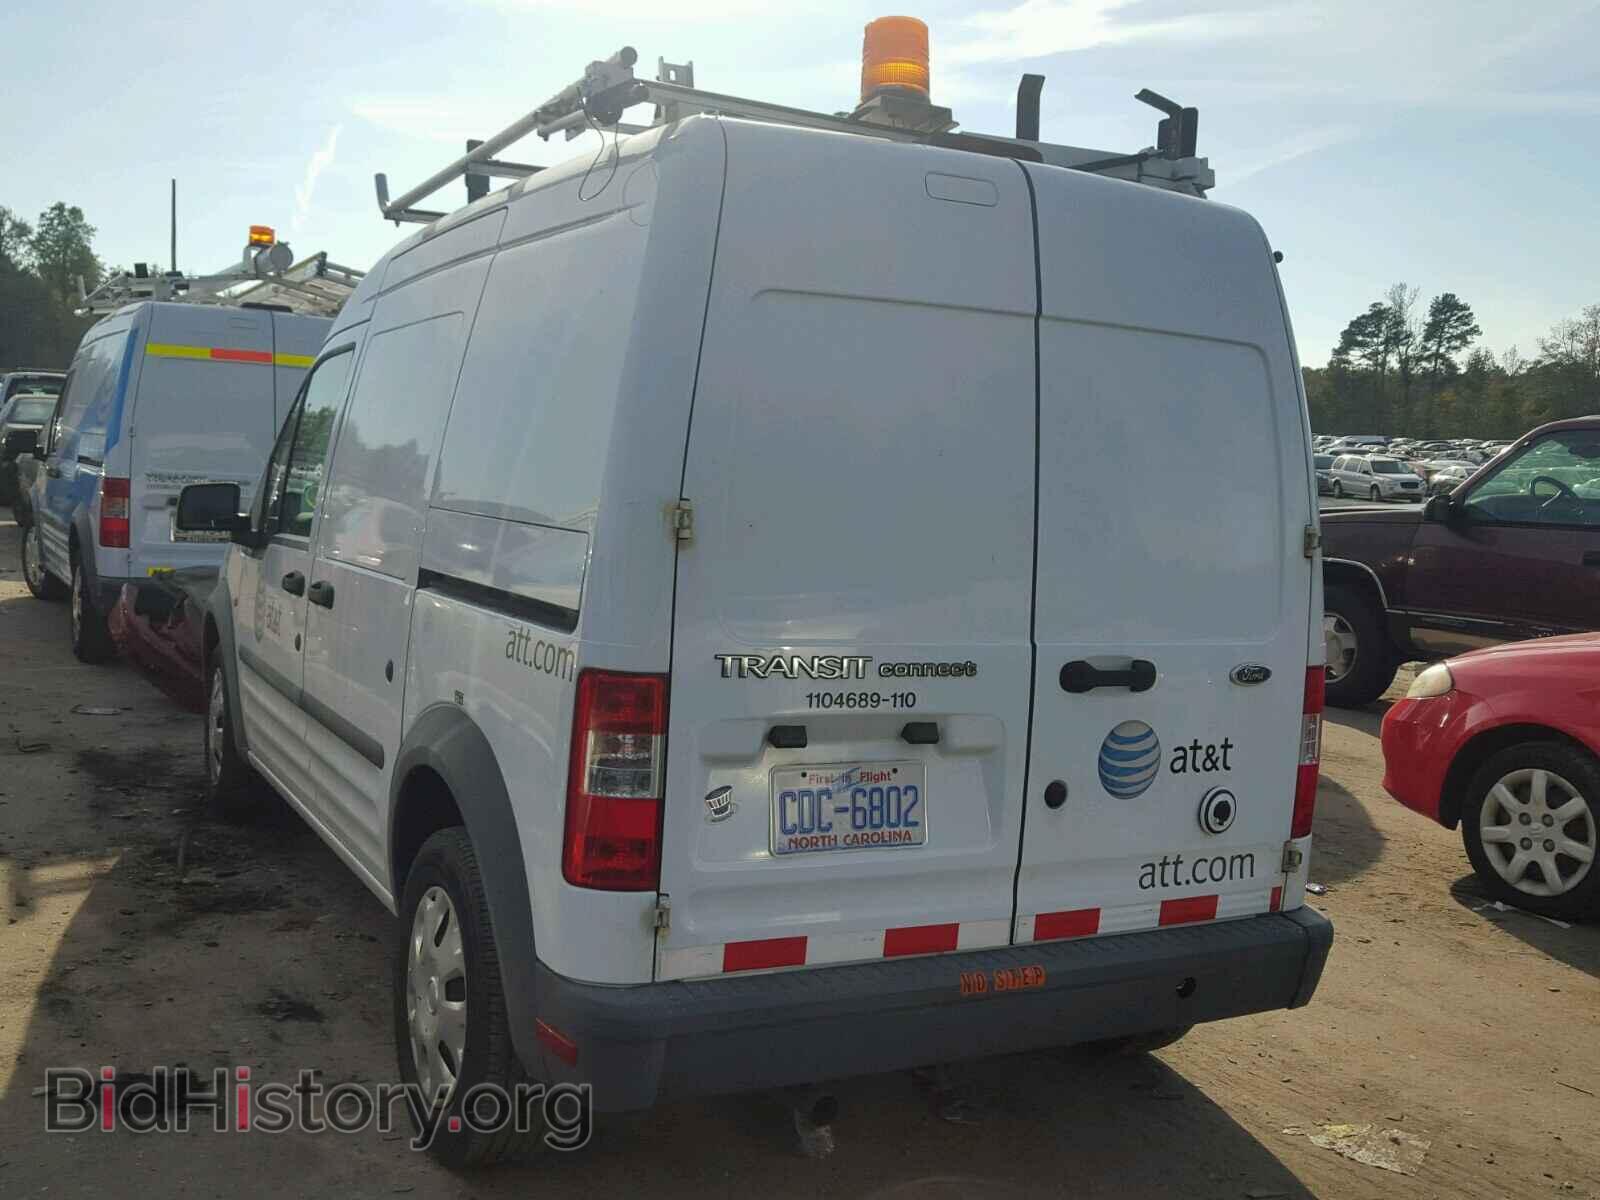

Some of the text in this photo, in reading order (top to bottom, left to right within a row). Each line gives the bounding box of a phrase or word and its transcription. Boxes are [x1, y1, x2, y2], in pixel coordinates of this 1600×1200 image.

[505, 626, 575, 682] att.com
[714, 653, 978, 680] TRANSIT connect
[805, 691, 918, 710] 1104689-110
[1169, 736, 1234, 774] at&t
[859, 770, 892, 784] Flight
[779, 784, 920, 836] CDC-6802
[788, 829, 913, 850] NORTH CAROLINA
[1138, 852, 1256, 890] att.com
[960, 972, 986, 993] NO
